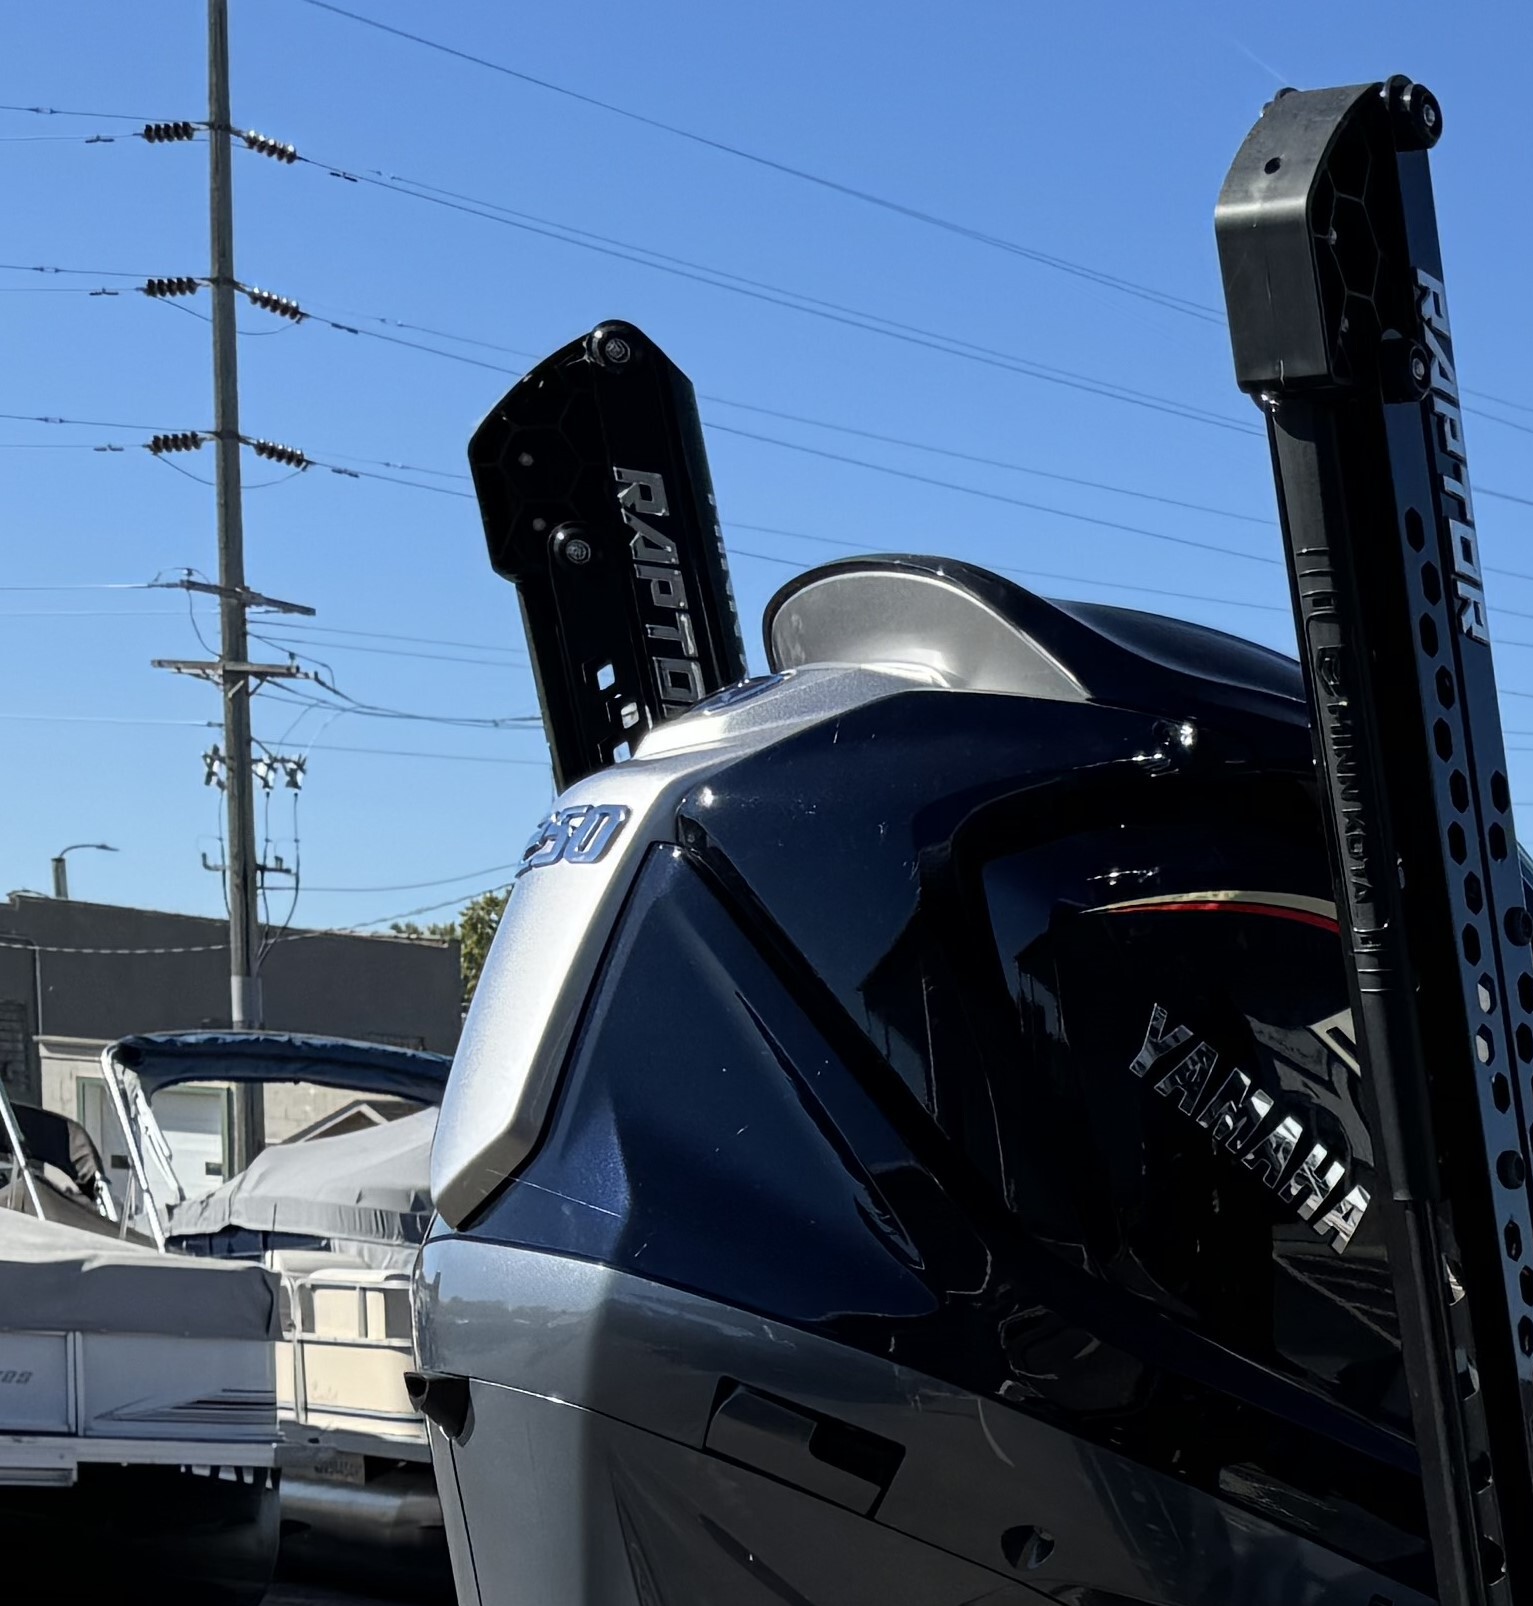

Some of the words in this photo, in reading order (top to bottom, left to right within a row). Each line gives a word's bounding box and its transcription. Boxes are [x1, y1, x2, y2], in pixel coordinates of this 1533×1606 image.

[1413, 267, 1490, 646] RAPTOR
[613, 465, 707, 720] RAPTO
[1129, 1002, 1371, 1255] YAMAHA
